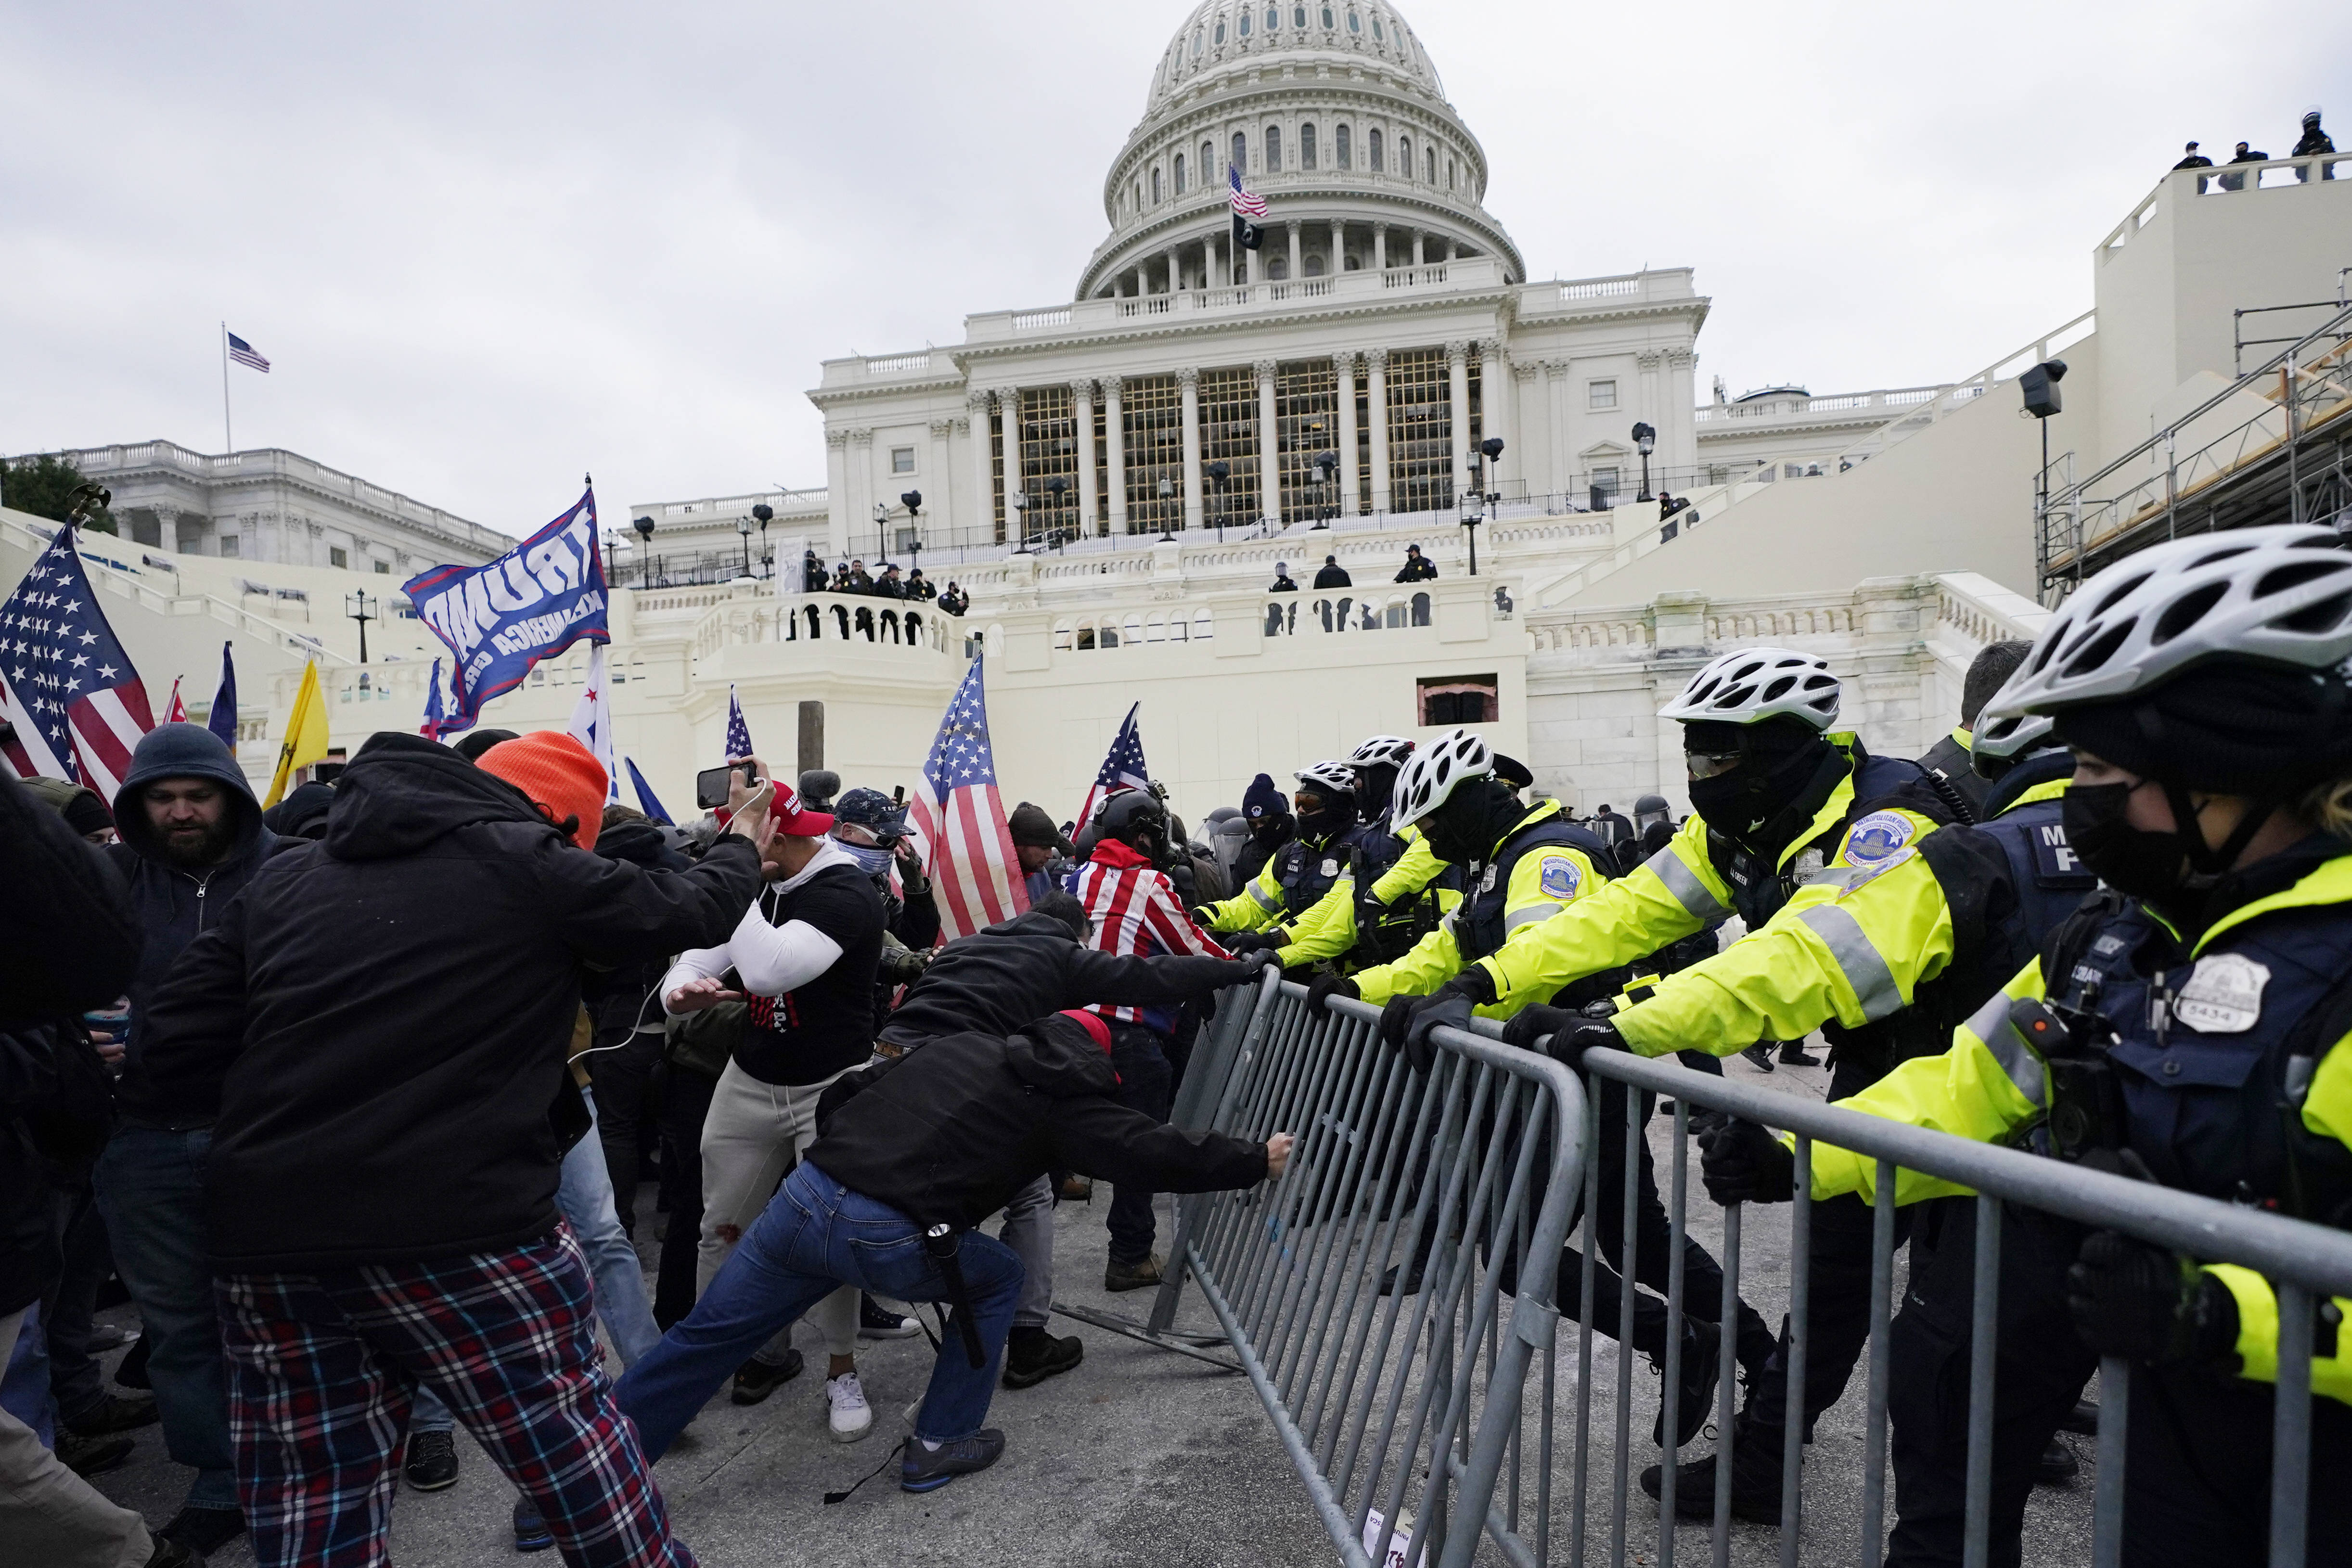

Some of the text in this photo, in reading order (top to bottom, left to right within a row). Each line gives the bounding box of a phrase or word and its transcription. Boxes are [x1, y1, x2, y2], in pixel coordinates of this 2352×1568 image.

[1808, 689, 1827, 699] BELL
[1855, 815, 1912, 834] METROPOLITAN POLICE
[1543, 859, 1570, 867] METROPOLITAN
[1735, 872, 1748, 886] GREEN
[1393, 1529, 1409, 1541] PINTUR
